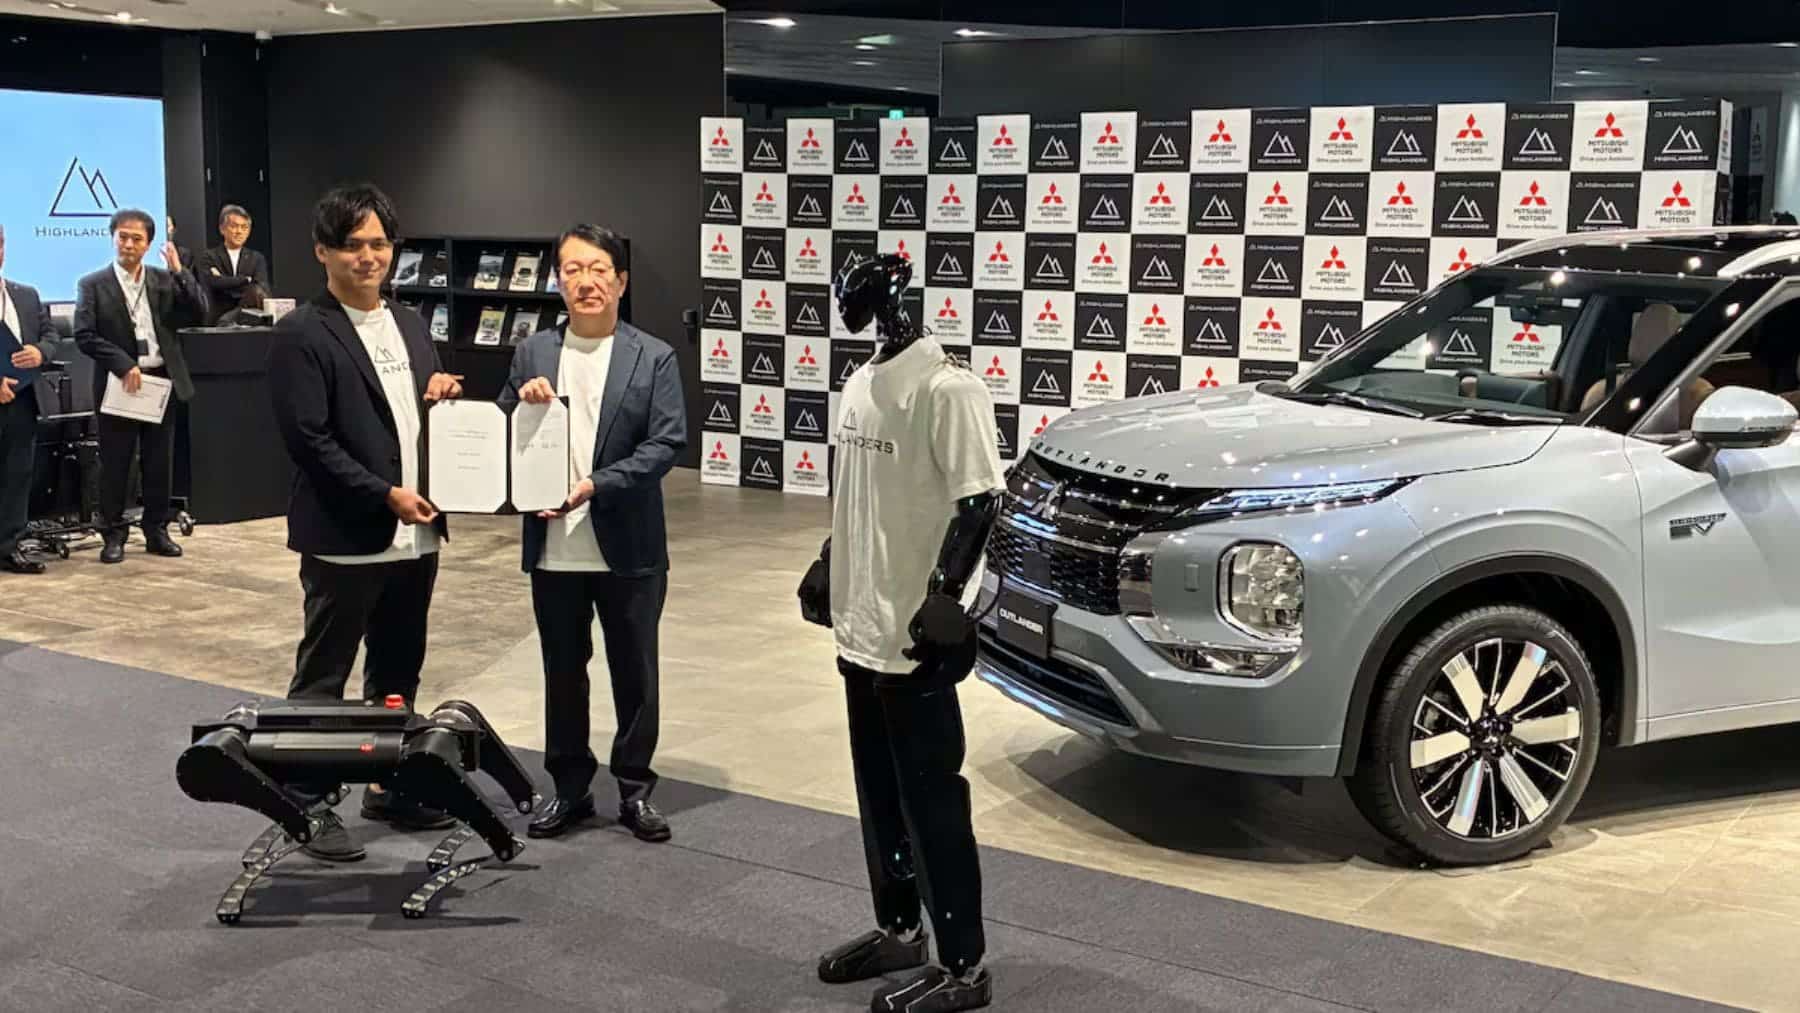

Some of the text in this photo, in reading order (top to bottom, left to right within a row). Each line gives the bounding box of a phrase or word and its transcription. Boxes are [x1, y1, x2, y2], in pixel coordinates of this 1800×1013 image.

[1506, 343, 1545, 351] MITSUBISHI
[1511, 350, 1539, 358] MOTORS
[999, 607, 1044, 636] OUTLANDER
